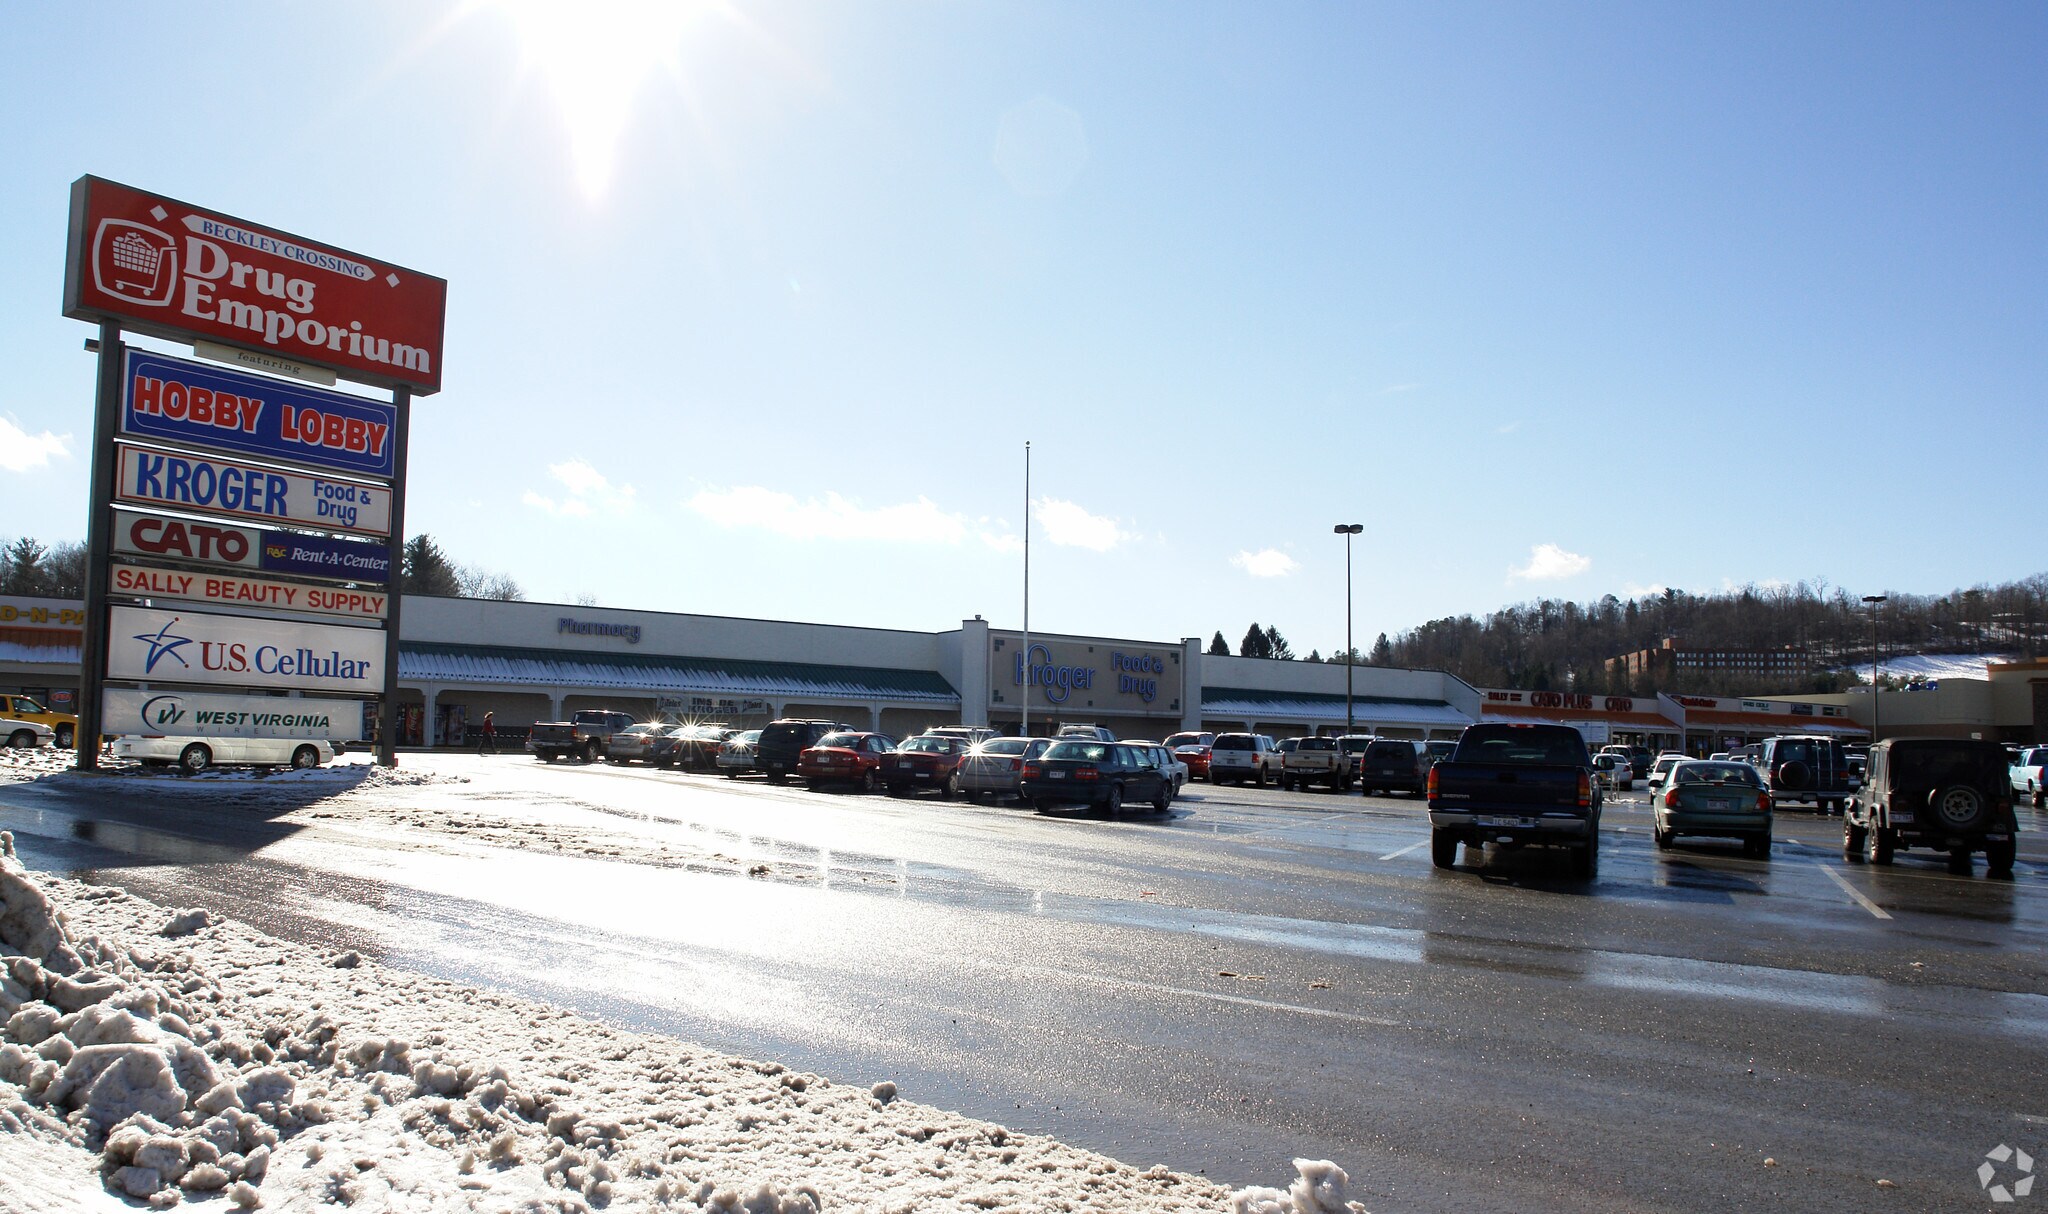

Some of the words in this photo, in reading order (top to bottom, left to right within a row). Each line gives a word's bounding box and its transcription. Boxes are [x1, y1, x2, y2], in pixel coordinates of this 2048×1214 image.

[203, 220, 282, 253] BECKLEY
[284, 244, 365, 278] CROSSING
[183, 234, 317, 314] Drug
[181, 275, 431, 374] Emporium
[238, 352, 301, 374] featuring
[132, 374, 264, 434] HOBBY
[280, 404, 390, 457] LOBBY
[136, 452, 288, 517] KROGER
[313, 479, 356, 503] Food
[359, 490, 372, 505] &
[316, 499, 358, 527] Drug
[130, 517, 250, 562] CATO
[116, 569, 194, 595] SALLY
[205, 578, 298, 605] BEAUTY
[307, 590, 385, 614] SUPPLY
[558, 617, 641, 644] Pharmacy
[199, 641, 251, 673] U.S.
[255, 645, 371, 680] Cellular
[1015, 643, 1096, 704] Kroger
[1112, 651, 1151, 673] Food
[1152, 657, 1164, 673] &
[692, 698, 735, 706] INSDE
[1119, 673, 1156, 702] Drug
[1530, 691, 1562, 708] CATO
[1563, 692, 1593, 709] PLUS
[195, 711, 250, 725] WEST
[252, 713, 330, 728] VIRGINIA
